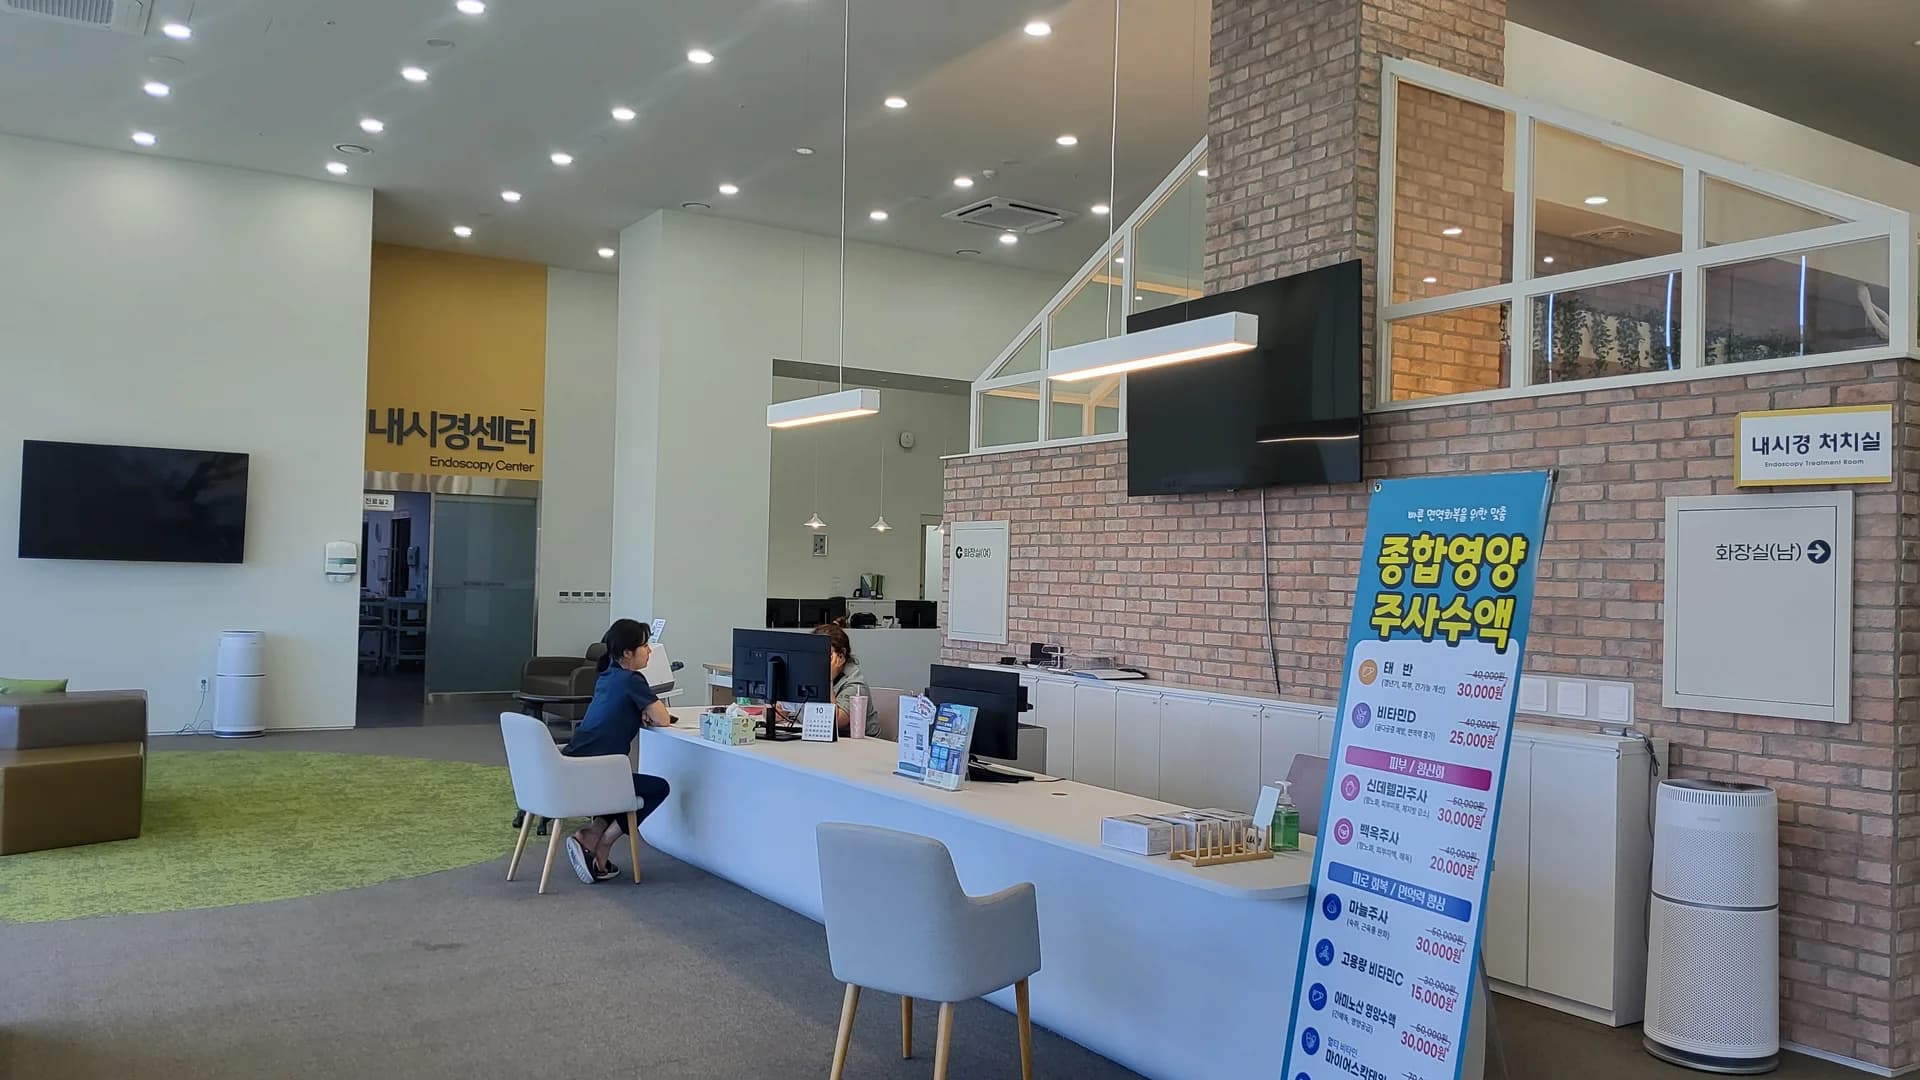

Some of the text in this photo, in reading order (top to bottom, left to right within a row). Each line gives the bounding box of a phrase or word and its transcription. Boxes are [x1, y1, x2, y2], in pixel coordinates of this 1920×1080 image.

[368, 407, 537, 454] 내시경센터
[1752, 431, 1882, 456] 내시경 처치실
[430, 456, 536, 472] Endoscopy Center
[1408, 506, 1507, 522] 빠른 면역회복을 위한 맞춤
[1378, 532, 1528, 590] 종합영양
[1716, 543, 1801, 562] 화장실(남)
[1371, 593, 1515, 649] 주사수액
[1457, 683, 1504, 700] 30,000원
[1377, 706, 1417, 723] 비타민D
[1450, 730, 1495, 749] 25,000원
[1390, 757, 1407, 771] 피부
[1417, 762, 1445, 779] 항산화
[1366, 778, 1428, 804] 신데렐라주사
[1437, 808, 1483, 830] 30,000원
[1360, 823, 1400, 845] 백옥주사
[1430, 856, 1475, 880] 20,000원
[1352, 871, 1370, 888] 피로
[1371, 877, 1389, 893] 회복
[1398, 884, 1426, 904] 면역력
[1427, 893, 1446, 912] 향상
[1348, 899, 1389, 924] 마늘주사
[1416, 936, 1462, 964] 30,000원
[1341, 951, 1404, 987] 고용량 비타민C
[1334, 991, 1397, 1030] 아미노산 영양수액
[1411, 983, 1455, 1013] 15,000원
[1328, 1036, 1358, 1058] 멀티 비타민
[1400, 1030, 1447, 1063] 30,000원
